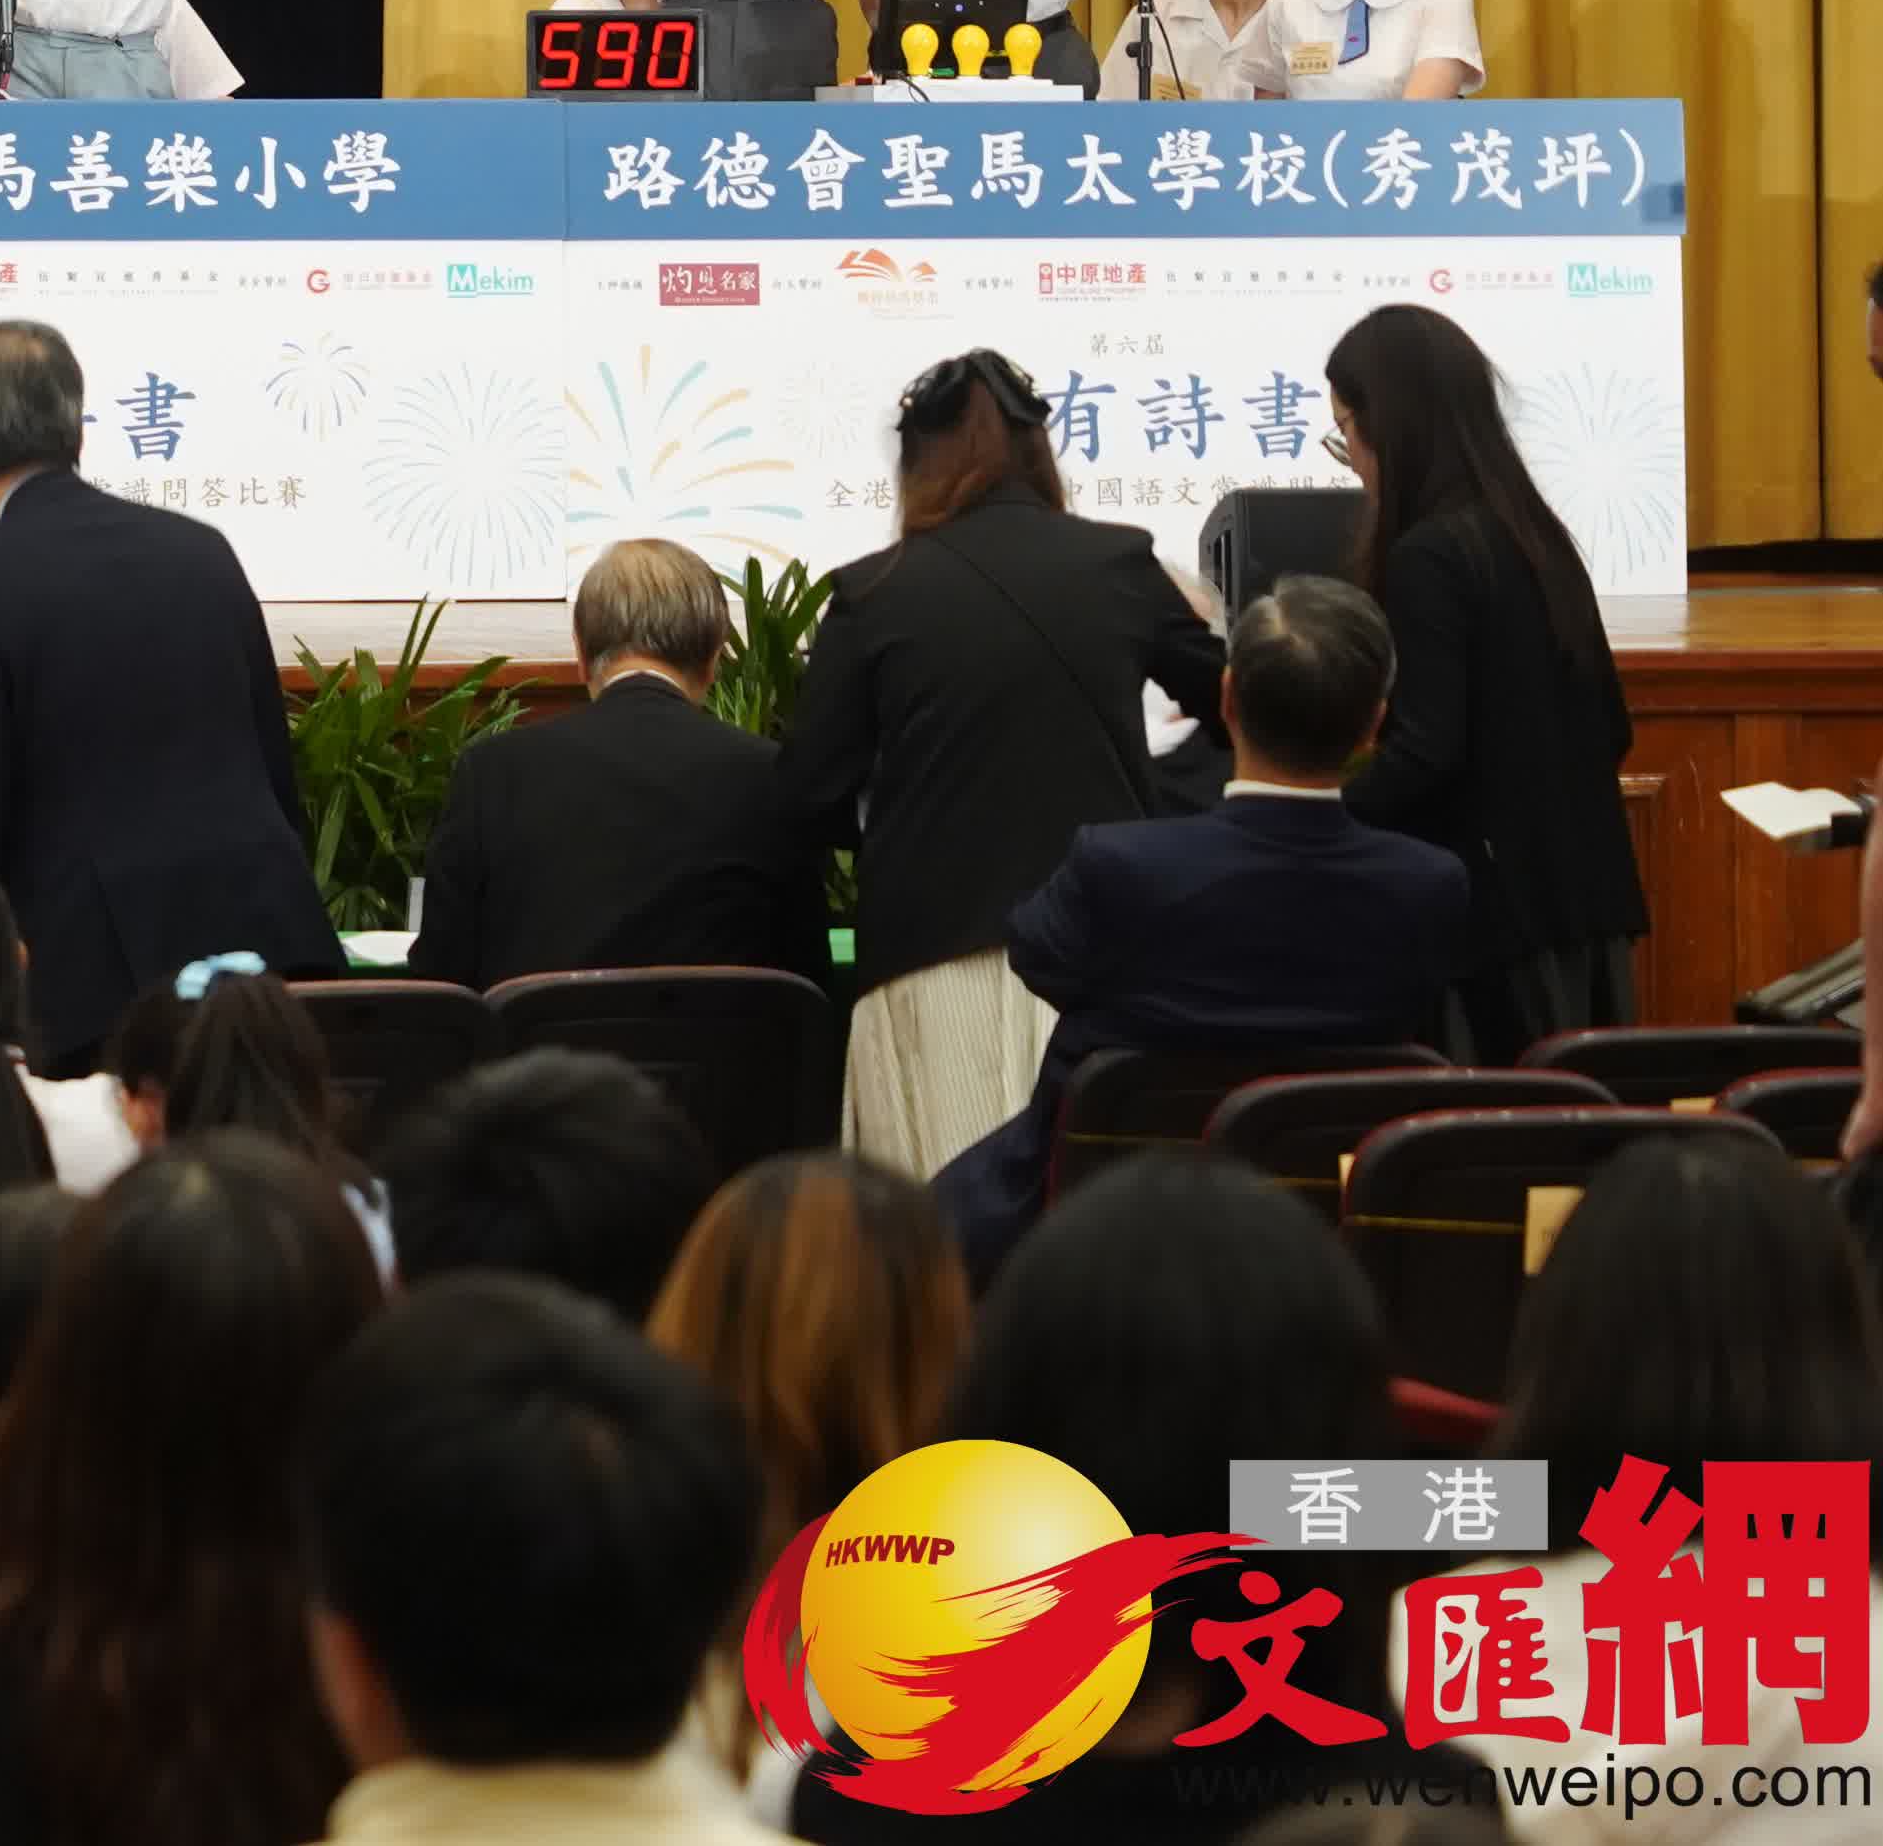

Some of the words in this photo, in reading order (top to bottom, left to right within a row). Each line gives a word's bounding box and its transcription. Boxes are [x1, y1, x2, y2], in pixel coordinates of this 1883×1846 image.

[539, 21, 695, 89] 590
[603, 127, 1648, 214] 路德會聖馬太學校(秀茂坪)
[447, 264, 535, 295] Mekim
[661, 265, 756, 295] 灼見名家
[1056, 262, 1147, 285] 中原地產
[1568, 263, 1653, 294] Mekim
[1089, 332, 1165, 357] 第六屆
